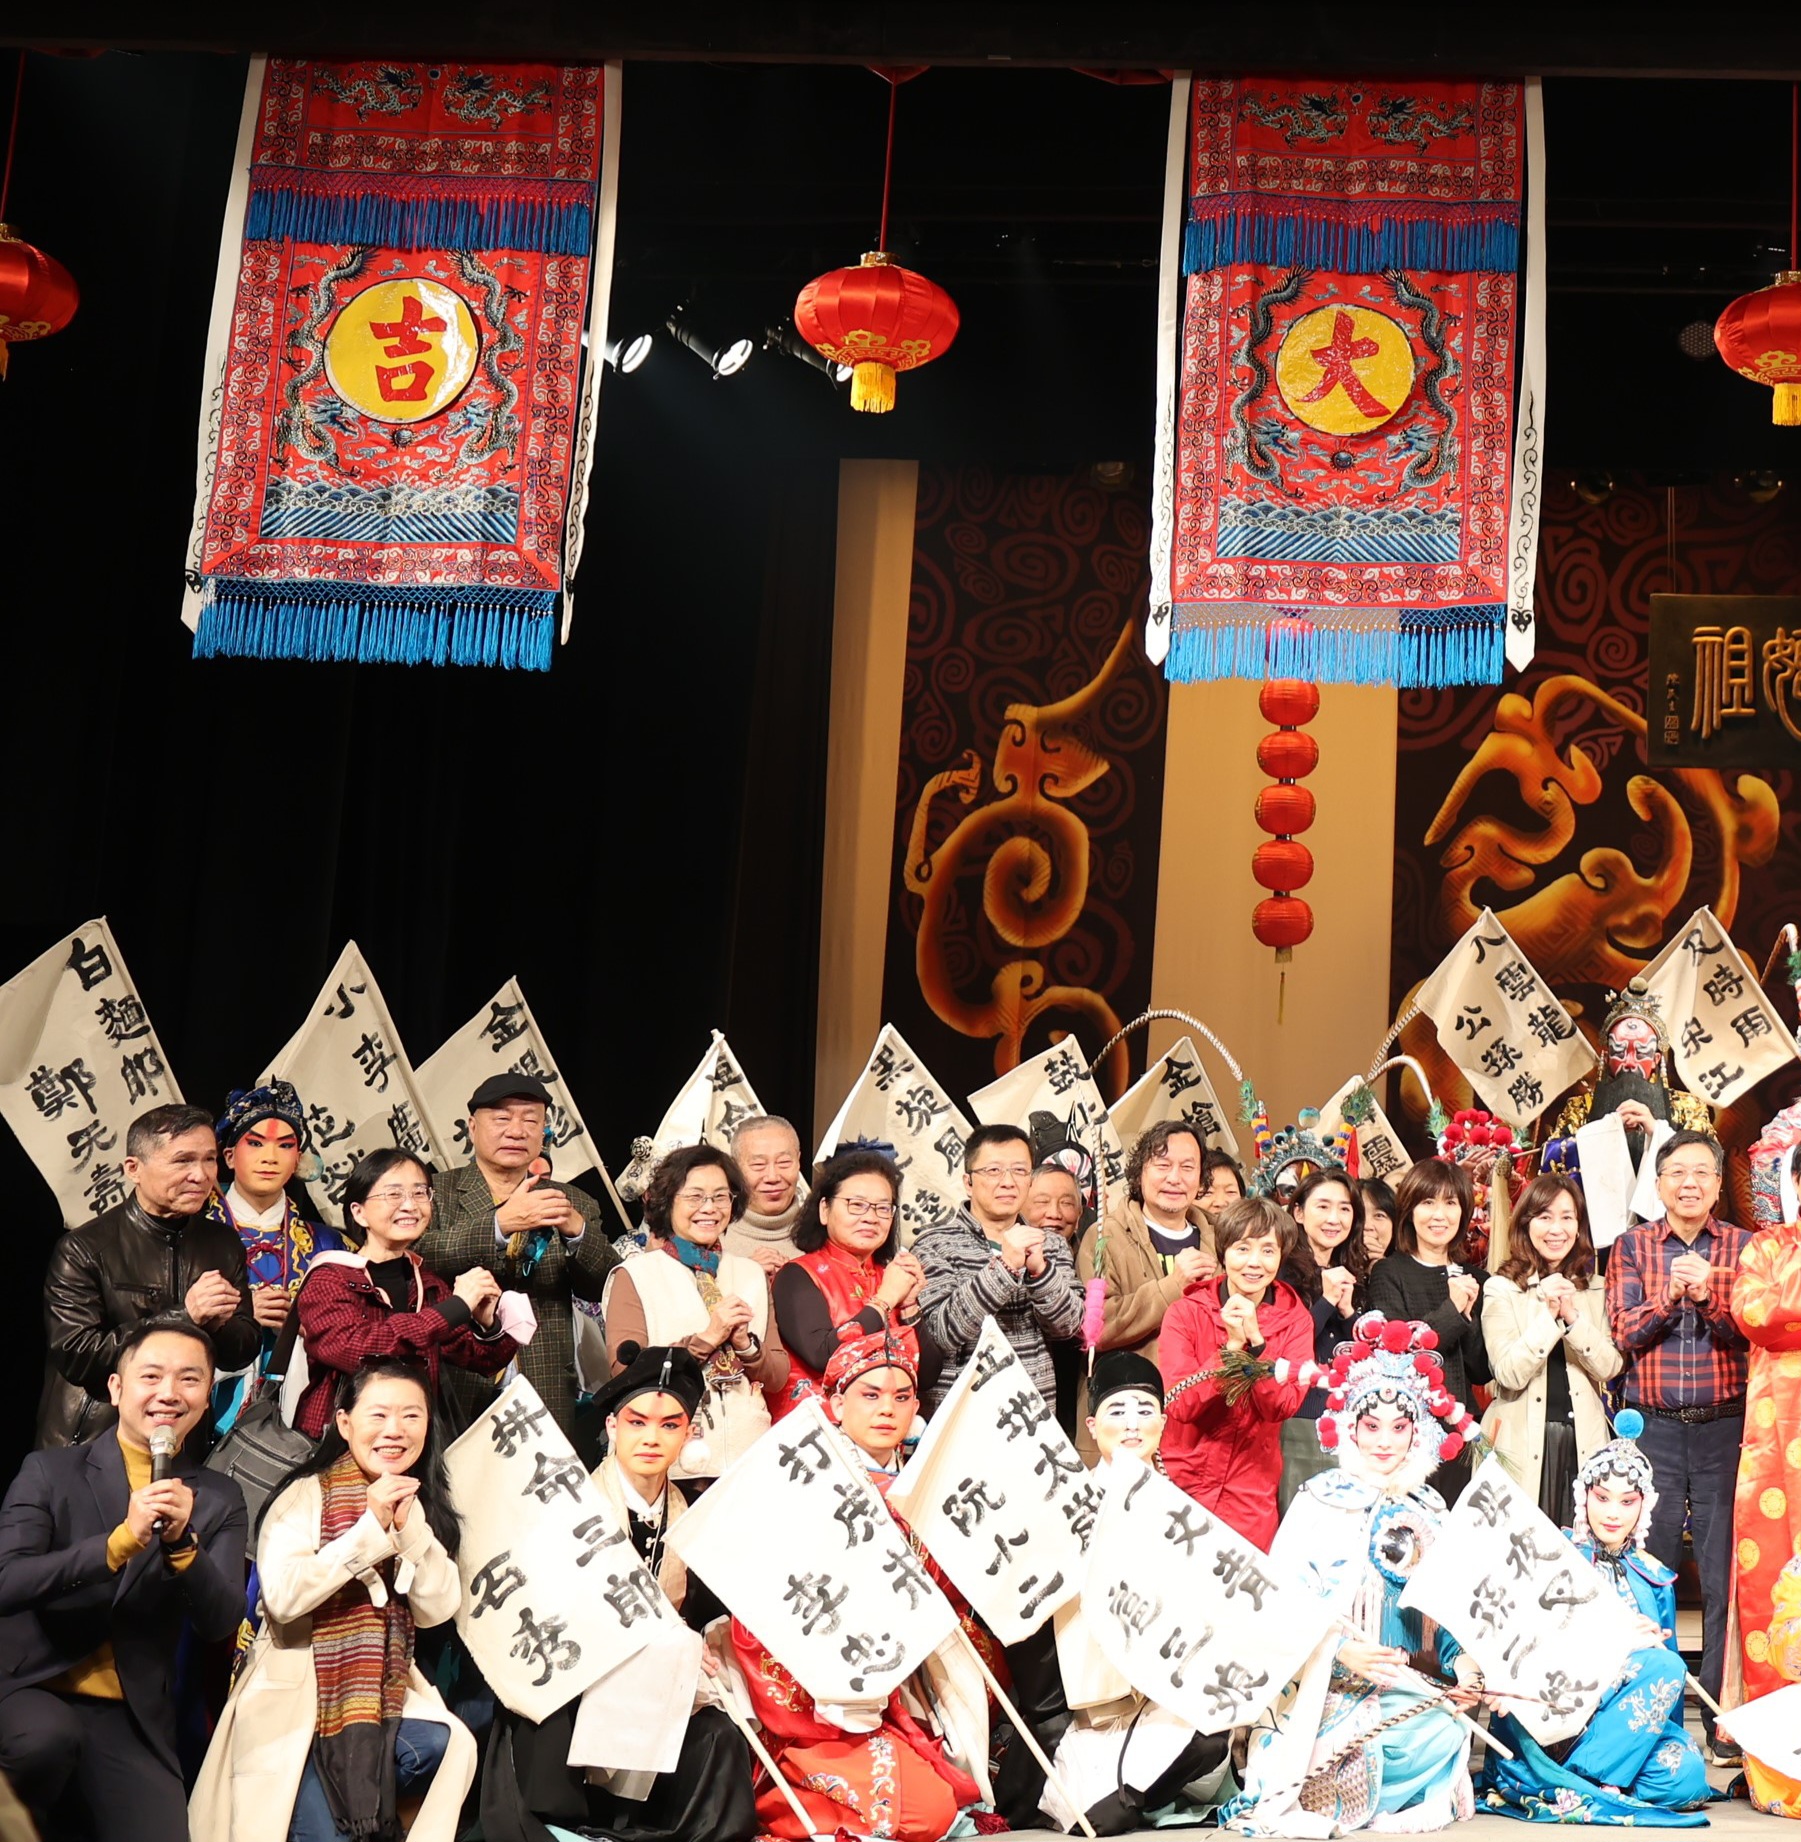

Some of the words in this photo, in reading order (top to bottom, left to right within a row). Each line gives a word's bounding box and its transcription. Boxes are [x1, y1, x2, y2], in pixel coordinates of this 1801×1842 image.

[369, 295, 447, 402] 吉
[1300, 310, 1392, 418] 大
[1682, 928, 1773, 1048] 及時雨
[1454, 1005, 1546, 1115] 公孫勝
[1682, 1016, 1746, 1100] 宋江
[24, 1057, 127, 1217] 鄭天壽
[941, 1476, 1065, 1620] 阮小二
[1123, 1466, 1280, 1612] 一丈青
[1467, 1480, 1600, 1630] 母夜叉
[469, 1549, 582, 1688] 石秀
[782, 1570, 907, 1693] 李忠
[1107, 1579, 1270, 1725] 扈三娘
[1468, 1574, 1600, 1723] 孫二娘
